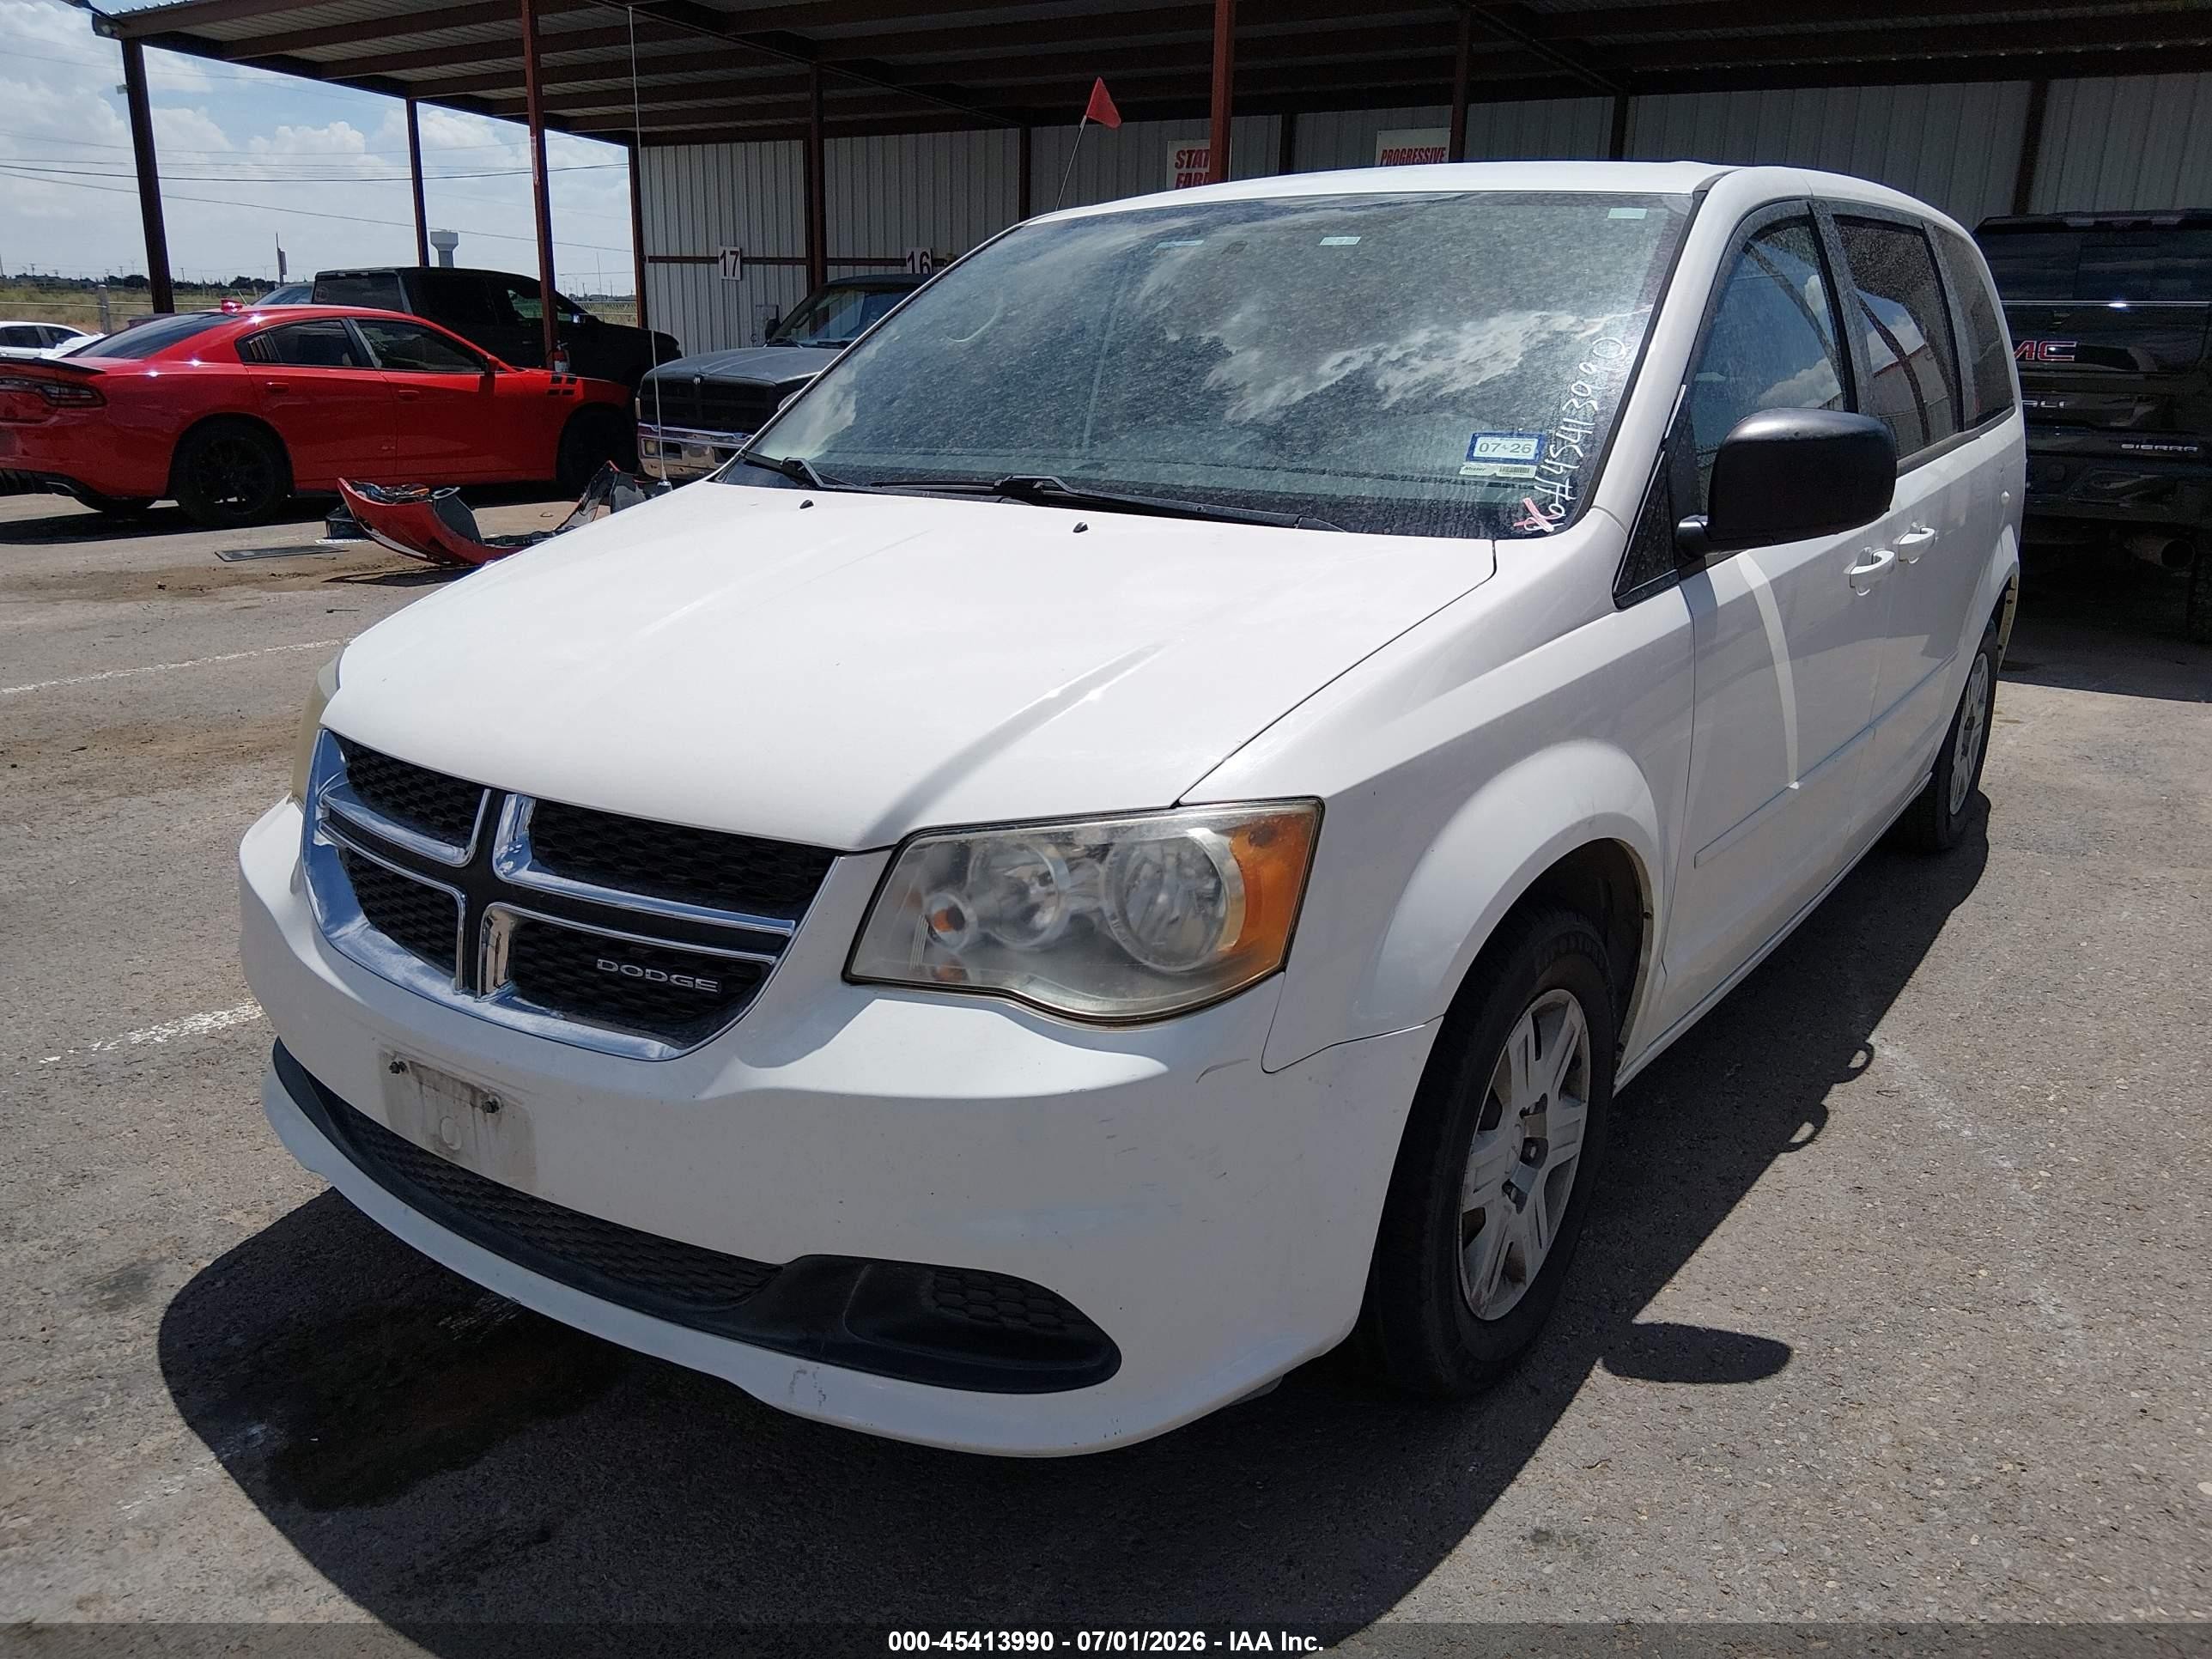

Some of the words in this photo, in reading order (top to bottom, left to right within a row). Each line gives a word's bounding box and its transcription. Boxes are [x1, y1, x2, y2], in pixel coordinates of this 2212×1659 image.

[1175, 149, 1209, 169] STAT
[1380, 147, 1446, 167] PROGRESSIVE
[1176, 172, 1209, 189] FAR
[720, 249, 739, 277] 17
[907, 251, 931, 275] 16
[2120, 442, 2198, 453] SIERRA
[597, 958, 719, 993] DODGE
